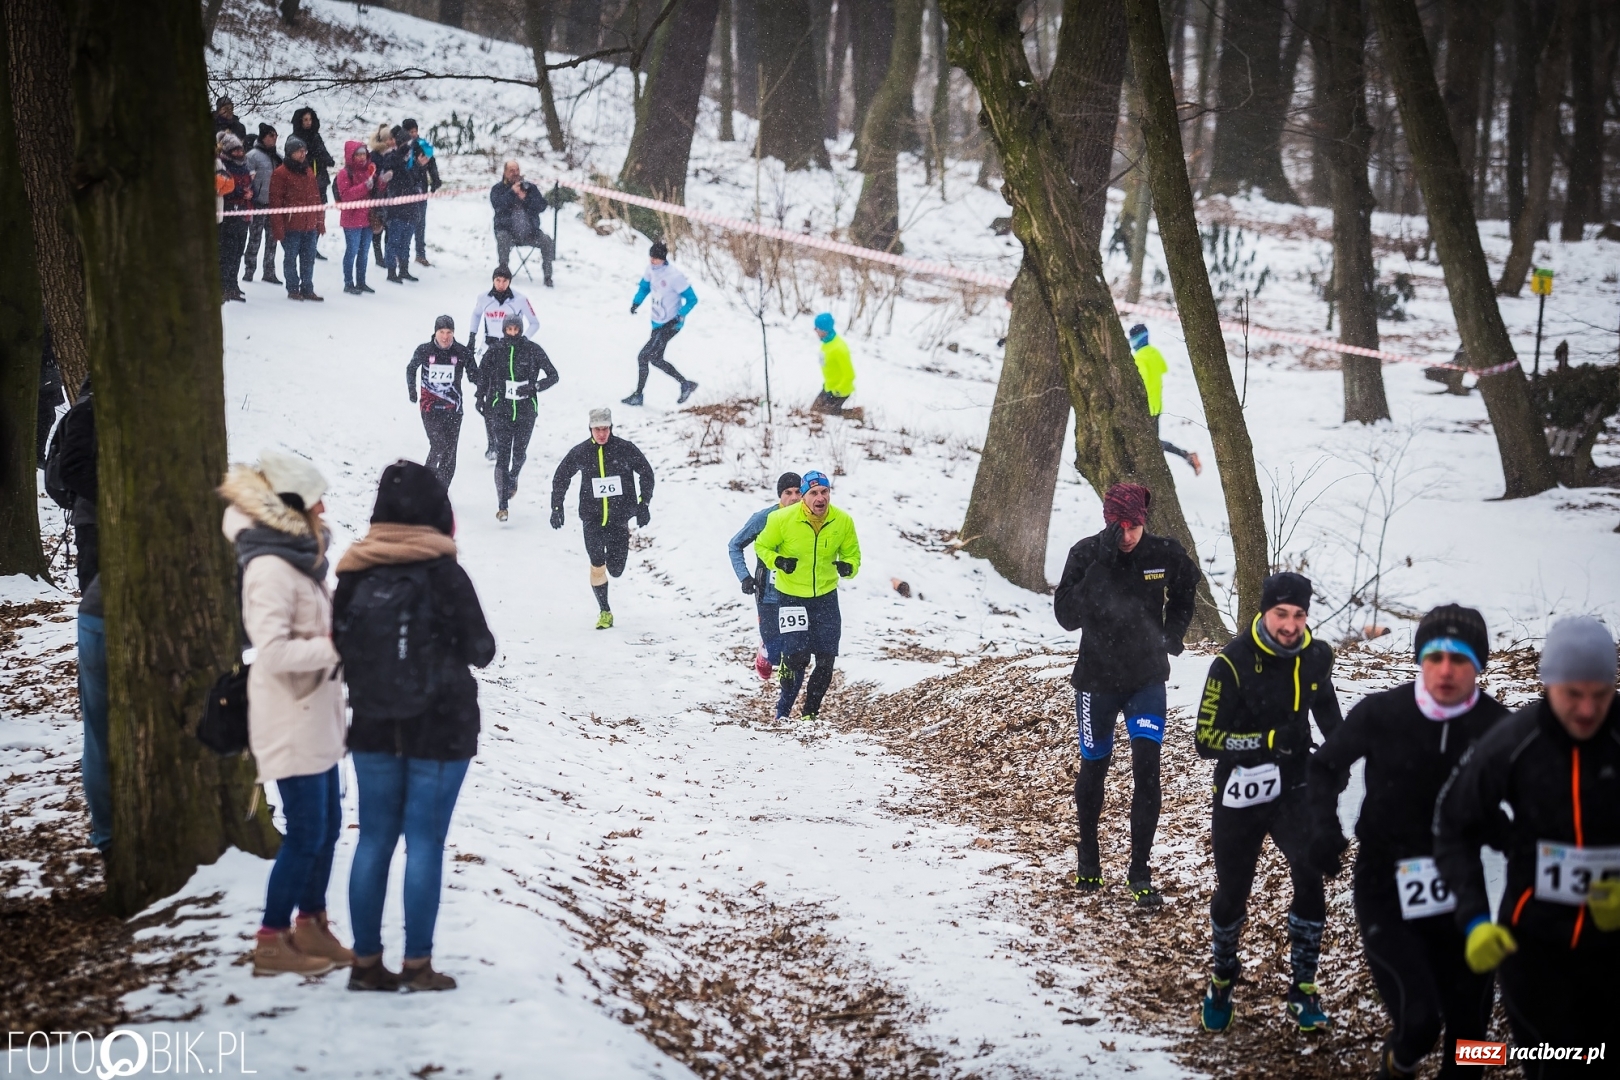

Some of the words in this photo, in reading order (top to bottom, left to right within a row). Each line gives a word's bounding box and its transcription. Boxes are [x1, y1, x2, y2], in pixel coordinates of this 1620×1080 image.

[431, 371, 453, 379] 274
[600, 484, 616, 494] 26
[780, 615, 807, 628] 295
[1227, 778, 1276, 800] 407
